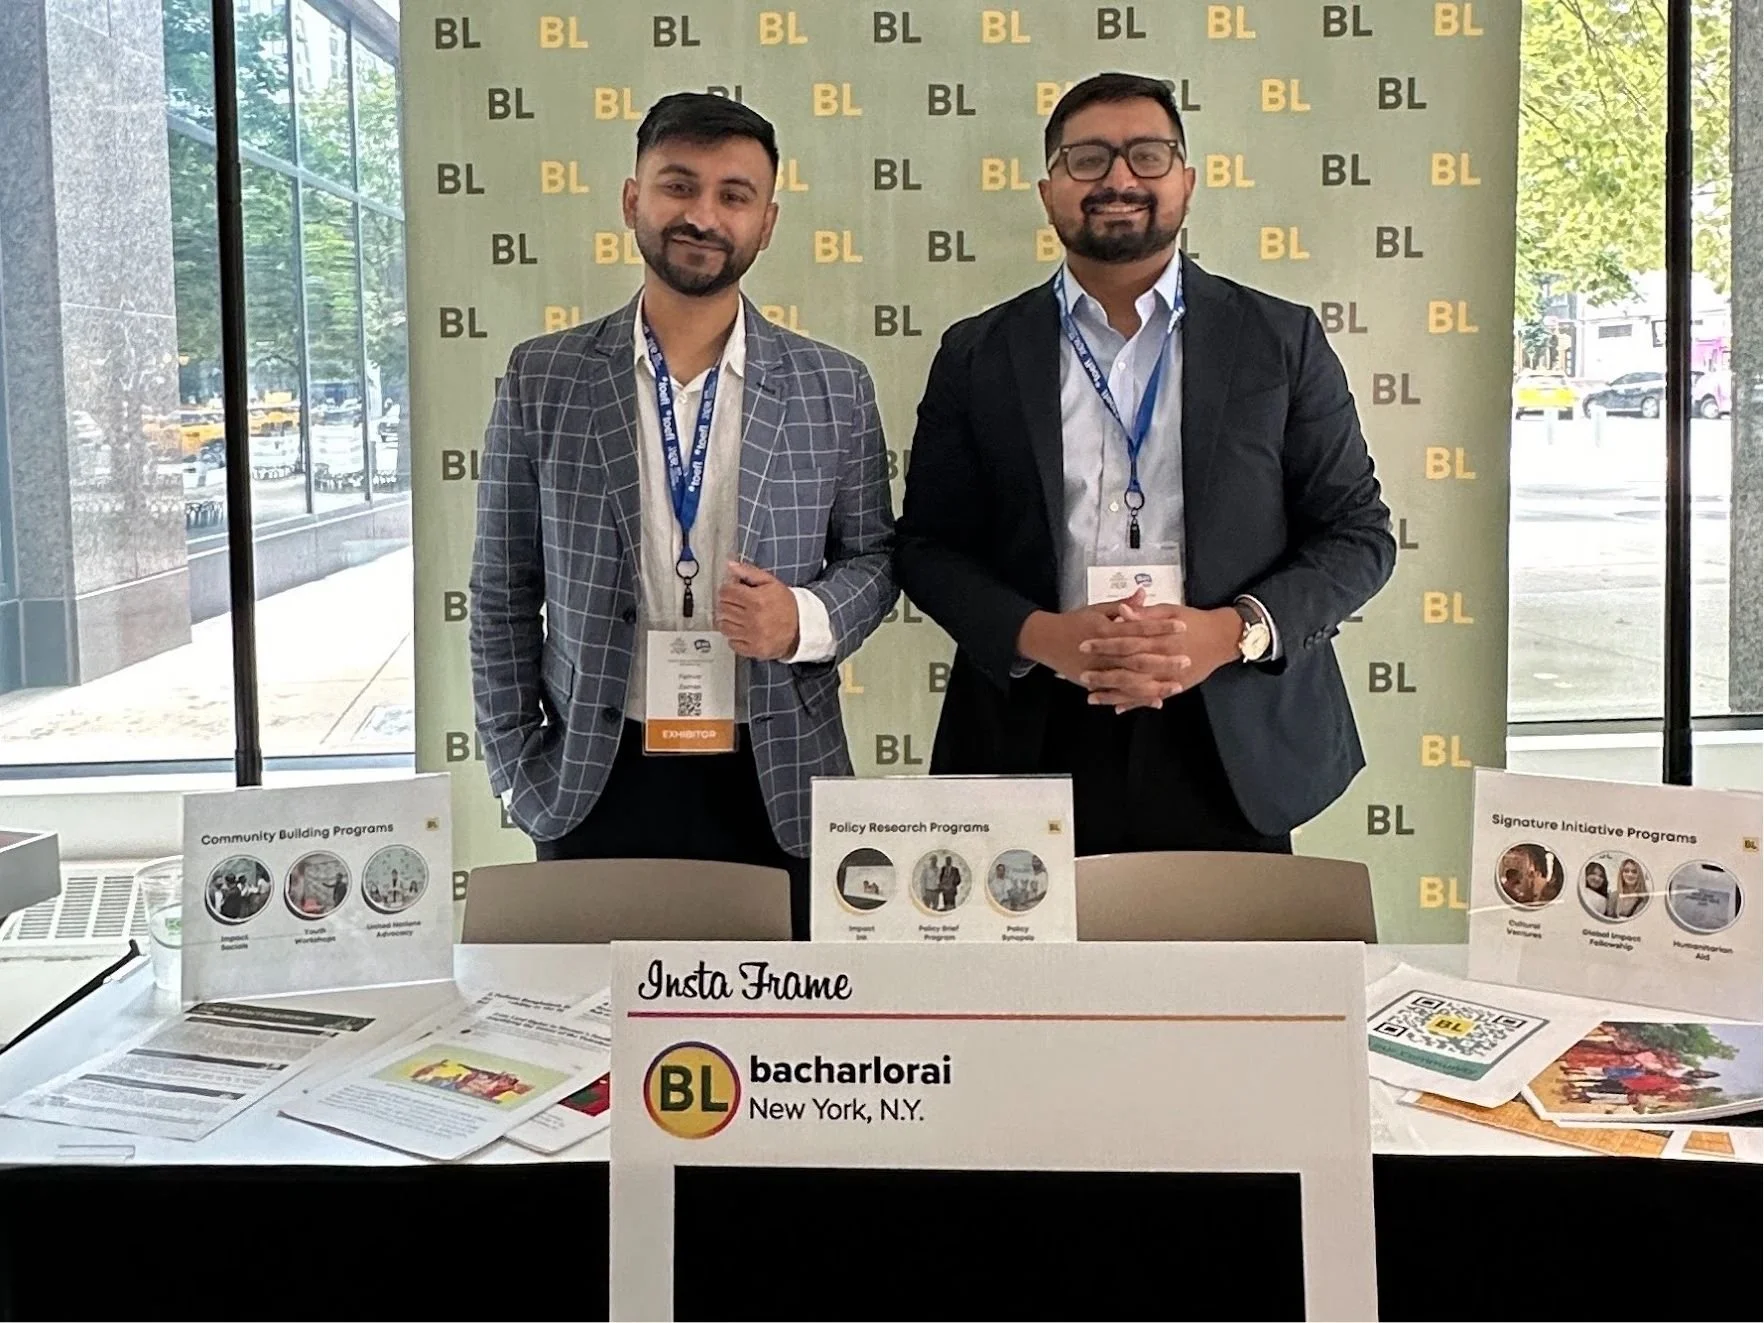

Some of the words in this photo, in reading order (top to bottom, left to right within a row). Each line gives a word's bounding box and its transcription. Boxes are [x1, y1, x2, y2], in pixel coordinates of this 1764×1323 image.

[435, 17, 480, 49] BL
[540, 17, 588, 48] BL
[654, 16, 700, 47] BL
[759, 12, 808, 45] BL
[873, 12, 921, 44] BL
[982, 11, 1030, 44] BL
[1097, 7, 1146, 39] BL
[1207, 6, 1255, 38] BL
[1323, 6, 1372, 37] BL
[1434, 3, 1483, 36] BL
[488, 87, 534, 119] BL
[595, 87, 642, 120] BL
[813, 83, 862, 116] BL
[928, 84, 975, 115] BL
[1036, 82, 1066, 115] B
[1262, 79, 1310, 112] BL
[1379, 77, 1426, 109] BL
[438, 163, 484, 194] BL
[541, 161, 589, 193] BL
[875, 158, 921, 191] BL
[982, 158, 1030, 191] BL
[1206, 155, 1255, 187] BL
[1322, 154, 1370, 186] BL
[1431, 153, 1481, 186] BL
[492, 233, 537, 265] BL
[594, 232, 642, 264] BL
[813, 231, 862, 263] BL
[928, 231, 975, 262] BL
[1260, 227, 1309, 260] BL
[1376, 227, 1423, 258] BL
[440, 307, 487, 338] BL
[875, 305, 921, 337] BL
[1321, 302, 1368, 334] BL
[1429, 302, 1478, 333] BL
[1373, 373, 1420, 405] BL
[1426, 446, 1475, 480] BL
[1423, 592, 1473, 624] BL
[1369, 662, 1416, 693] BL
[662, 730, 717, 739] EXHIBITOR
[876, 734, 923, 765] BL
[1421, 735, 1471, 767] BL
[201, 831, 276, 845] Community
[279, 827, 330, 840] Building
[333, 823, 394, 836] Programs
[829, 822, 867, 834] Policy
[869, 822, 927, 833] Research
[930, 823, 990, 834] Programs
[1367, 804, 1414, 835] BL
[1492, 814, 1558, 830] Signature
[1561, 821, 1624, 837] Initiative
[1627, 828, 1697, 844] Programs
[1419, 877, 1467, 908] BL
[1673, 940, 1733, 954] Humanitarian
[638, 960, 733, 1000] Insta
[739, 962, 852, 1000] Frame
[1434, 1019, 1464, 1032] BL
[750, 1055, 952, 1085] bacharlorai
[660, 1065, 729, 1112] BL
[750, 1098, 805, 1120] New
[812, 1098, 872, 1124] York,
[881, 1100, 924, 1121] N.Y.
